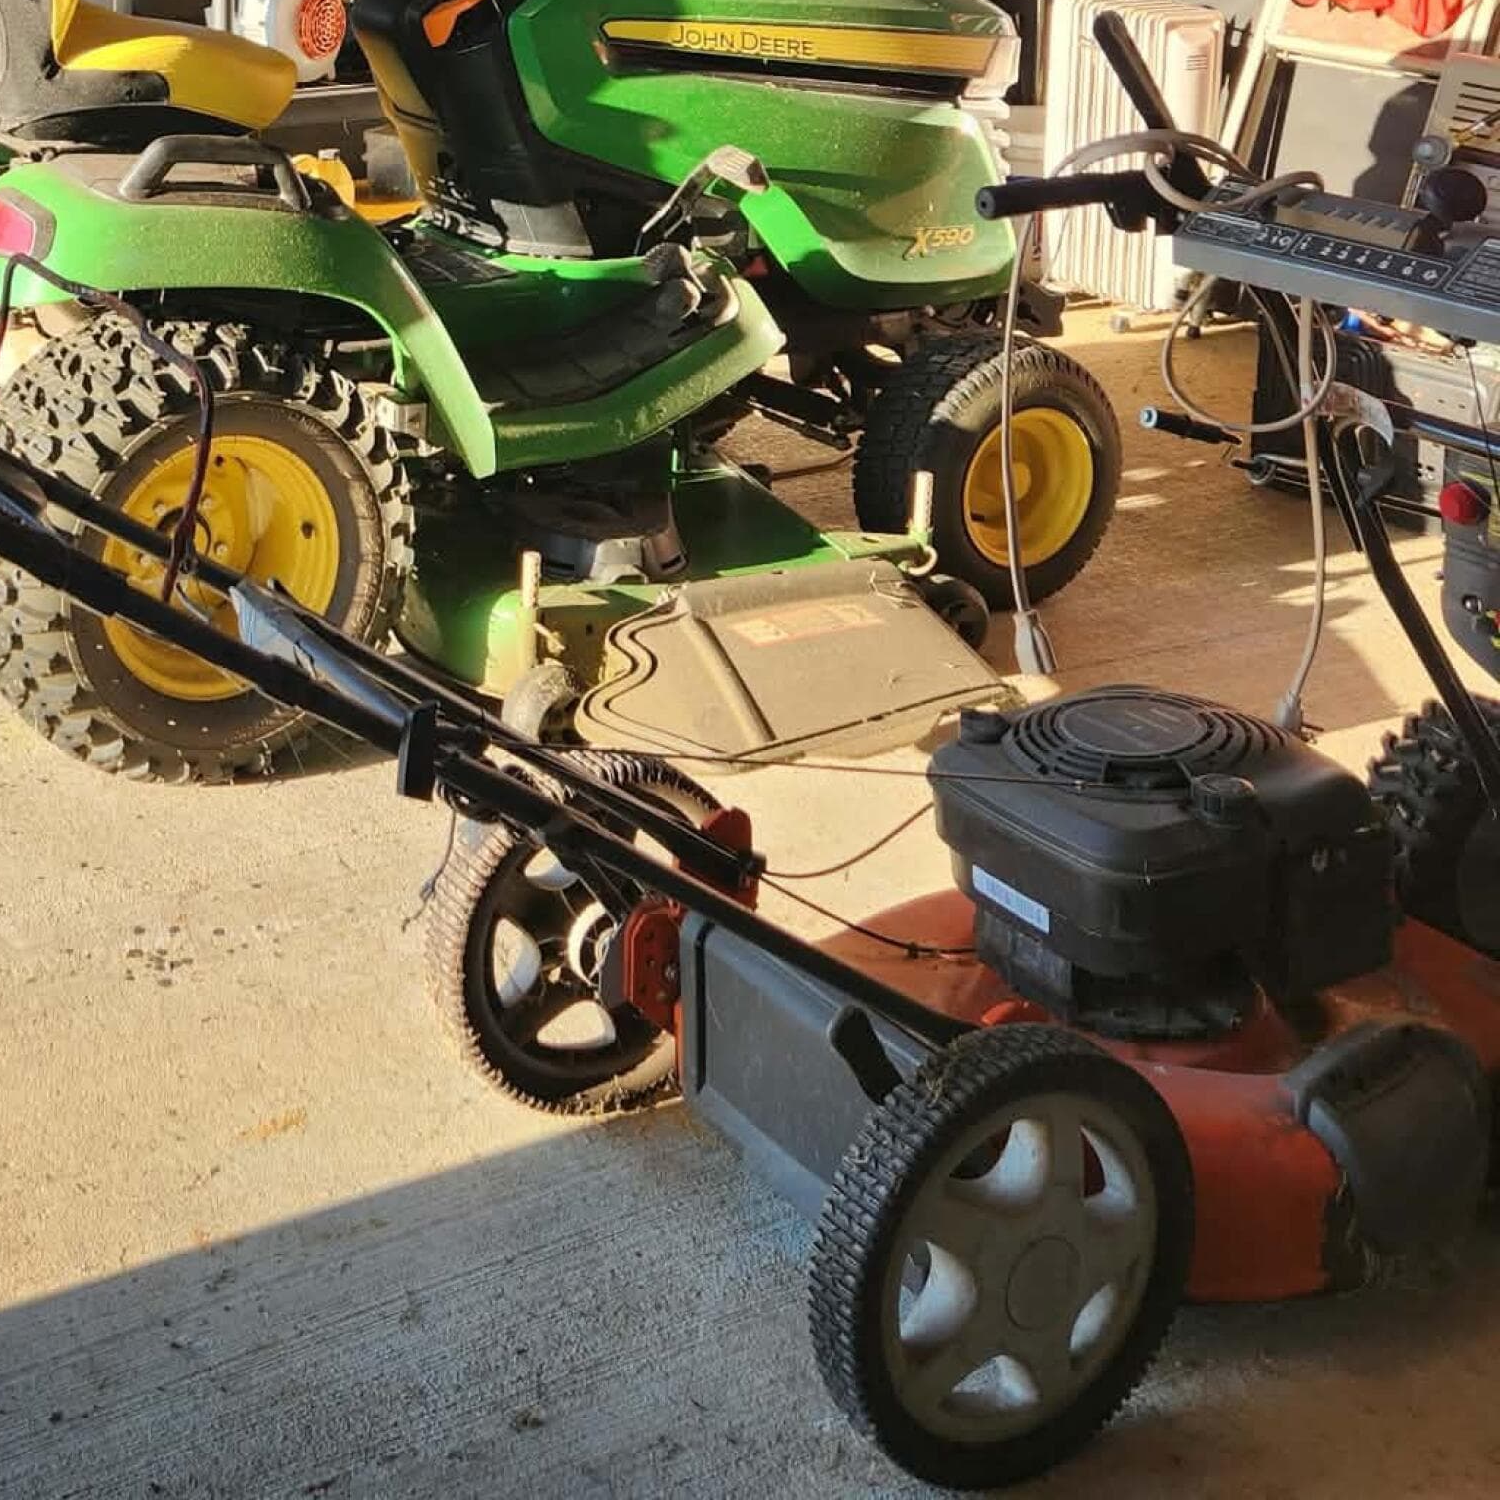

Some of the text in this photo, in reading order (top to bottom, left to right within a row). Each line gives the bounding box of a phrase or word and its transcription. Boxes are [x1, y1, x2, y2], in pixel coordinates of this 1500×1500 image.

[672, 25, 816, 59] JOHN DEERE
[902, 226, 977, 260] X590
